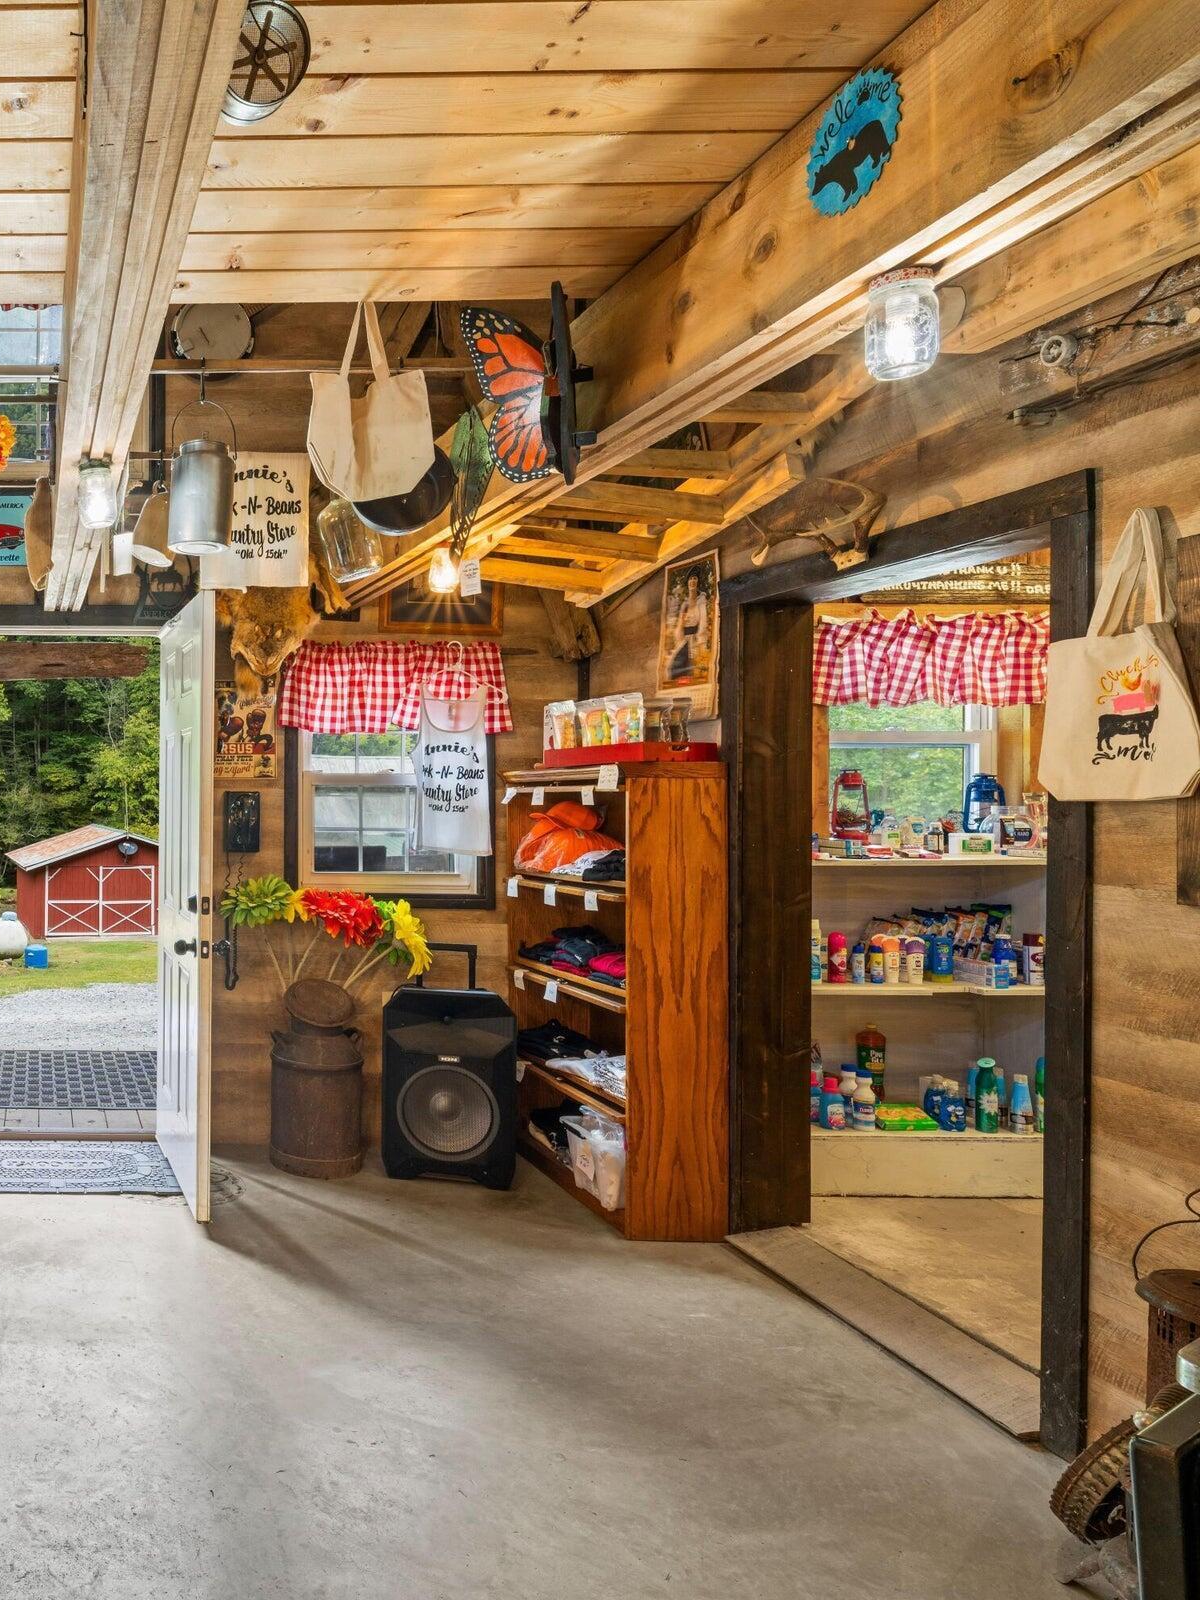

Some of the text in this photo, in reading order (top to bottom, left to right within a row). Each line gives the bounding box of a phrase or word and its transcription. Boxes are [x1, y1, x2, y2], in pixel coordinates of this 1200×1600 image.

[233, 465, 294, 493] nnie's
[265, 496, 301, 516] Beans
[231, 520, 297, 557] untry Store
[223, 743, 253, 754] RSUS
[456, 765, 484, 780] Beans
[455, 783, 479, 801] Store
